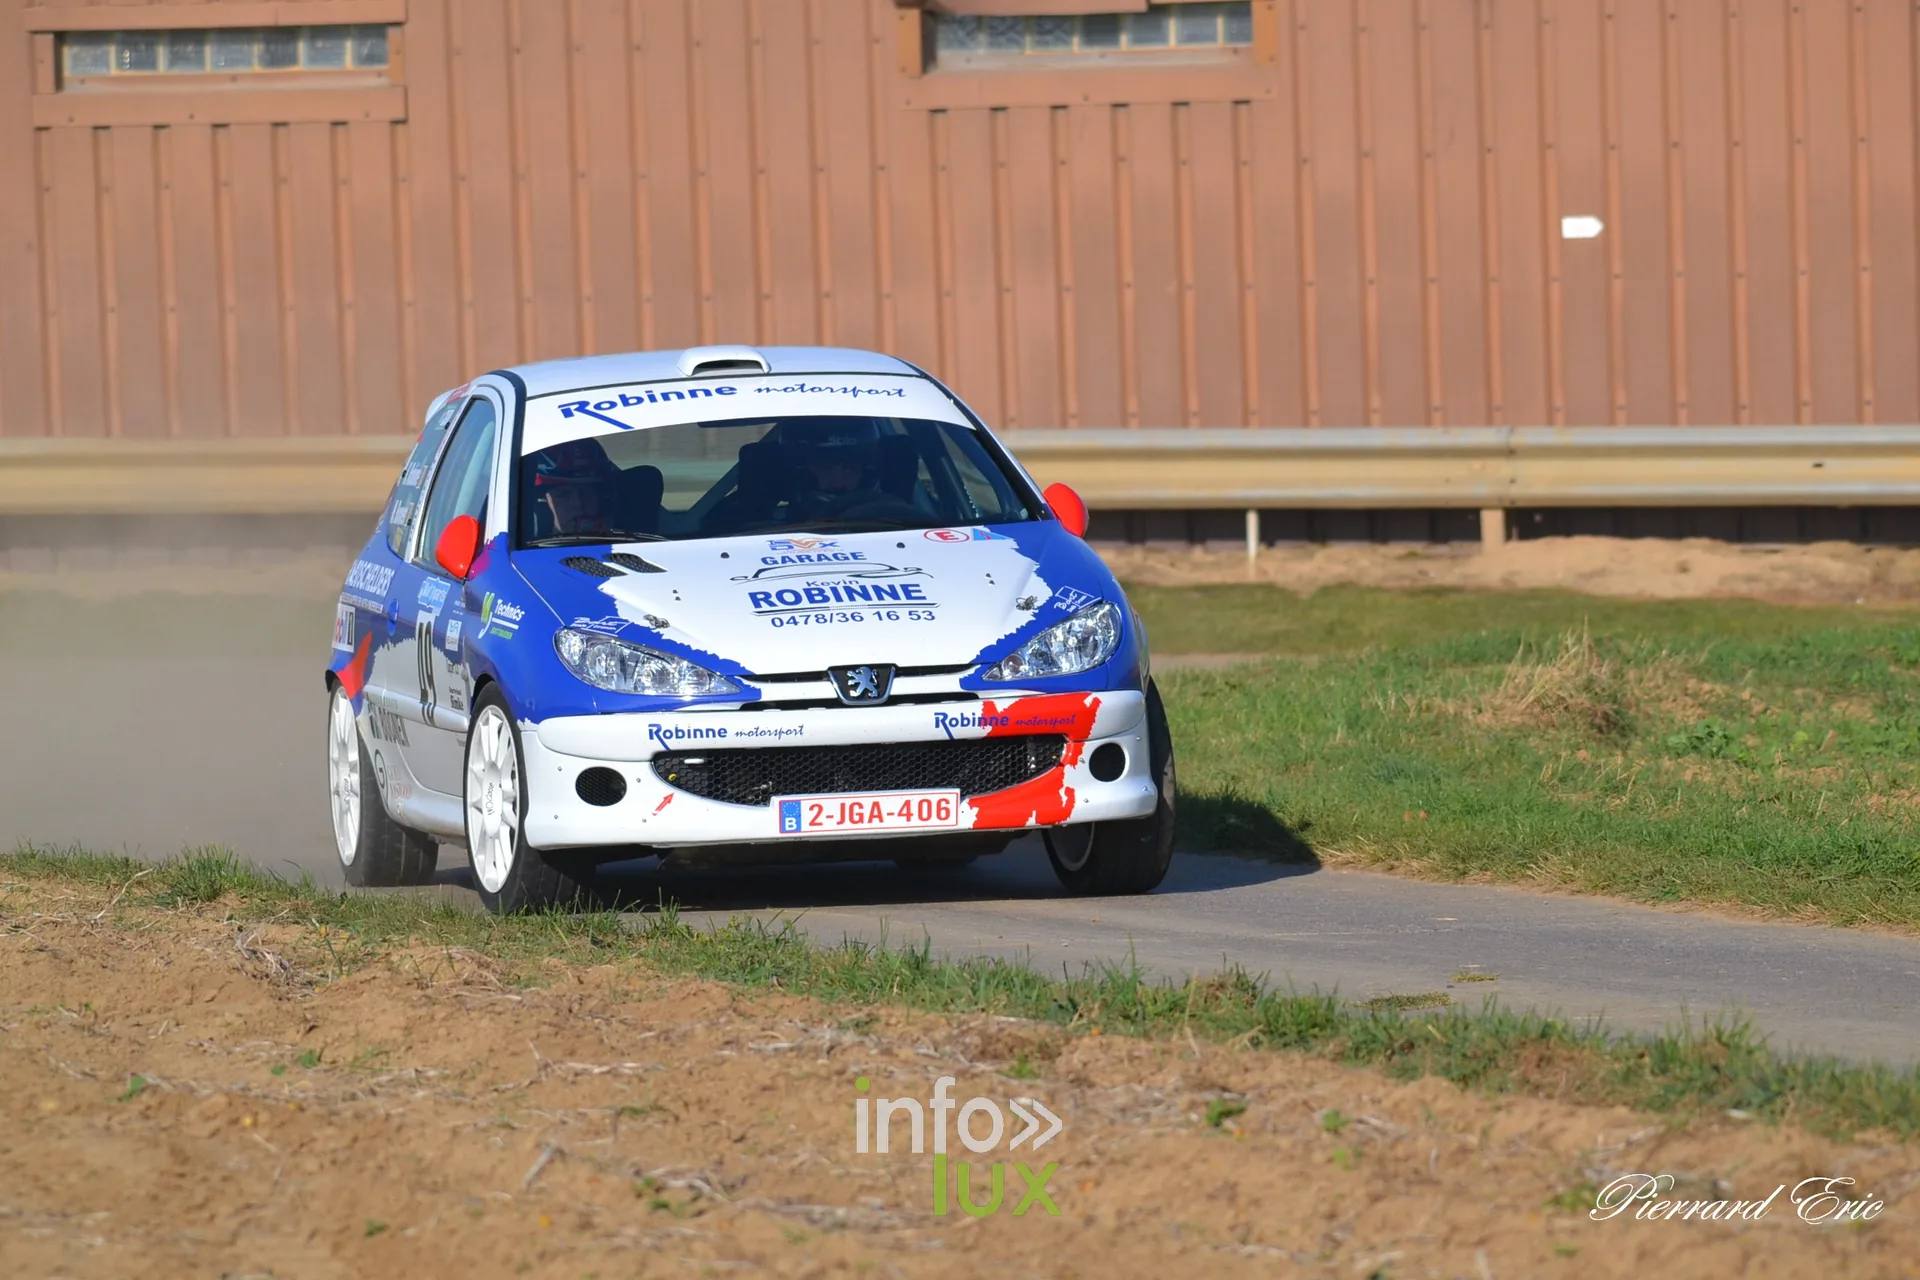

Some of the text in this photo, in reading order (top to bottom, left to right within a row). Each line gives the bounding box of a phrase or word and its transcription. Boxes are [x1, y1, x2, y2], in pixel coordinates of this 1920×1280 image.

[557, 382, 907, 430] Robinne motorsport
[760, 551, 868, 566] GARAGE
[748, 583, 928, 609] ROBINNE
[805, 577, 860, 588] Kevin
[770, 609, 936, 629] 0478/36 16 53
[648, 723, 804, 752] Robinne motorsport
[934, 711, 1077, 740] Robinne motorsport
[785, 798, 952, 832] B 2-JGA-406
